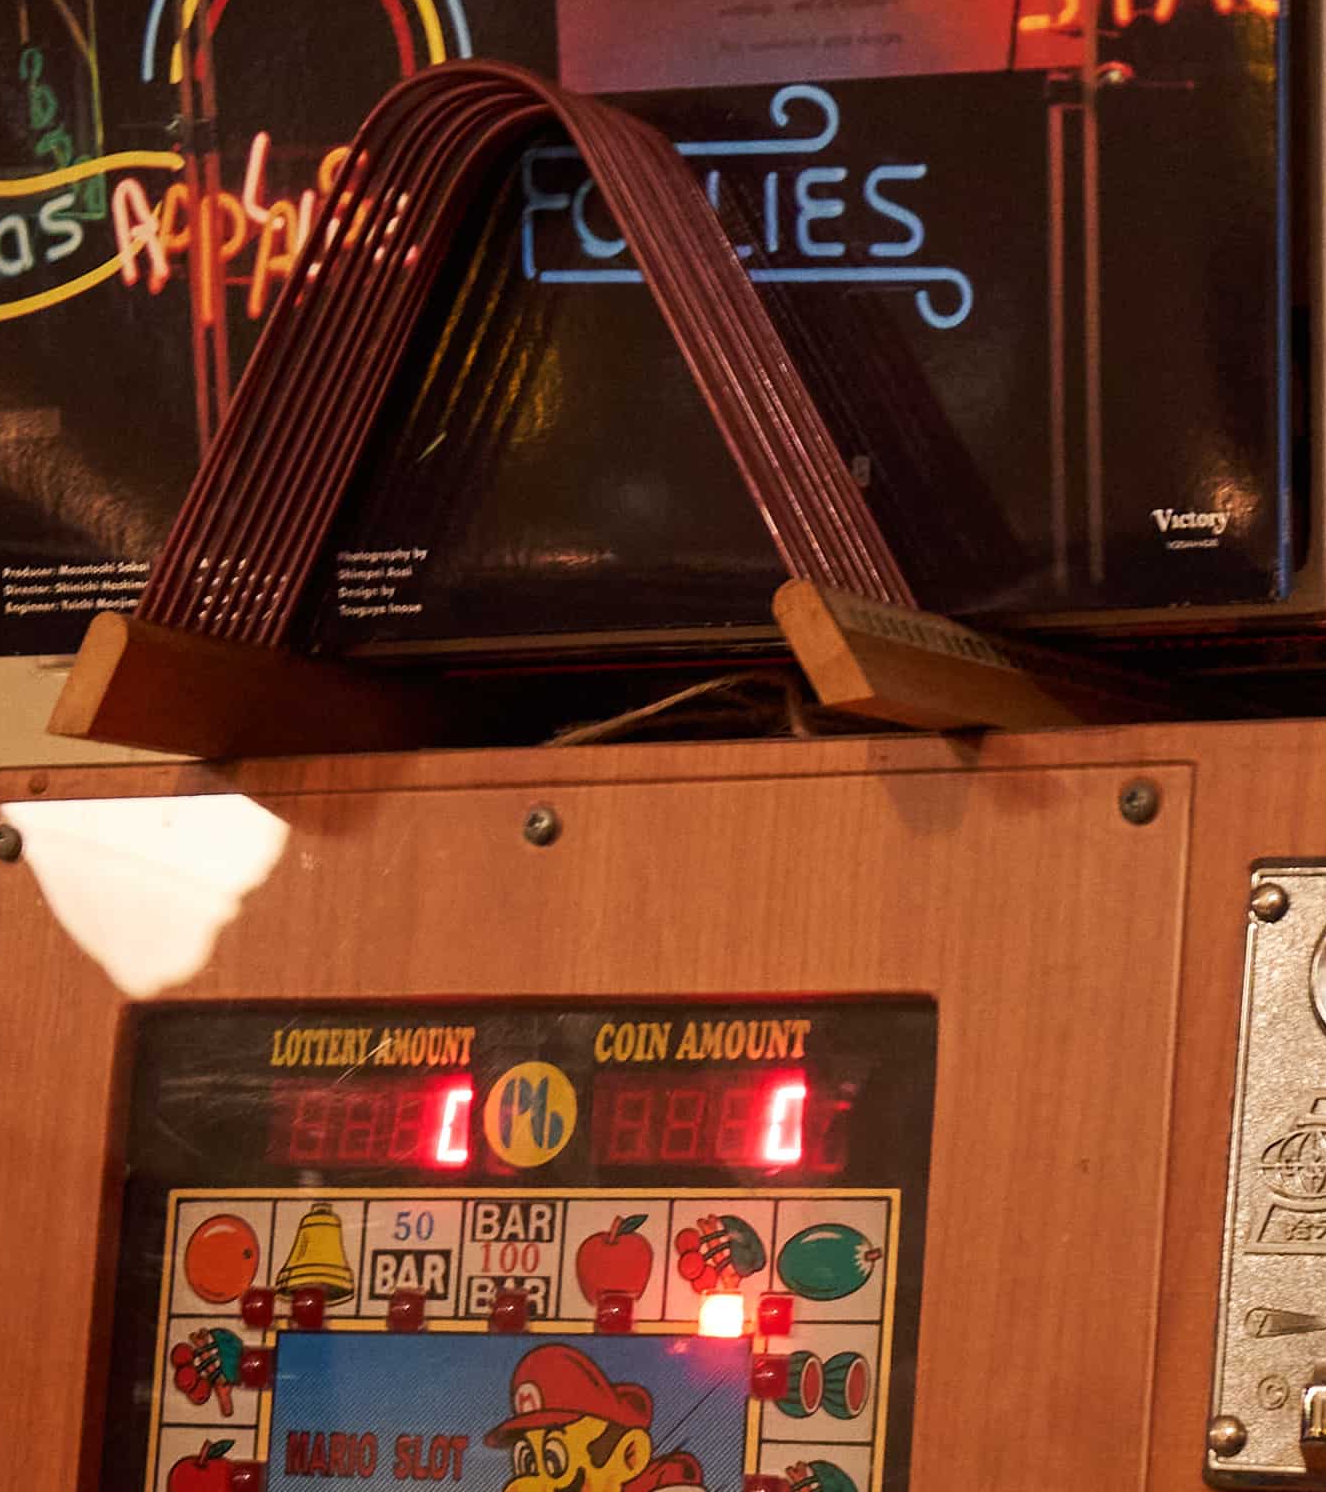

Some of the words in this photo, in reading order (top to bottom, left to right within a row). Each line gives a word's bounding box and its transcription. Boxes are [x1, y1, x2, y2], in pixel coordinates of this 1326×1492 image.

[1150, 508, 1230, 535] Victory
[270, 1027, 372, 1067] LOTTERY
[374, 1026, 475, 1067] AMOUNT
[594, 1021, 672, 1063] COIN
[675, 1018, 811, 1062] AMOUNT
[392, 1211, 435, 1241] 50
[474, 1203, 553, 1241] BAR
[373, 1253, 446, 1296] BAR
[480, 1242, 541, 1273] 100
[285, 1430, 378, 1479] MARIO
[393, 1433, 470, 1481] SLOT
